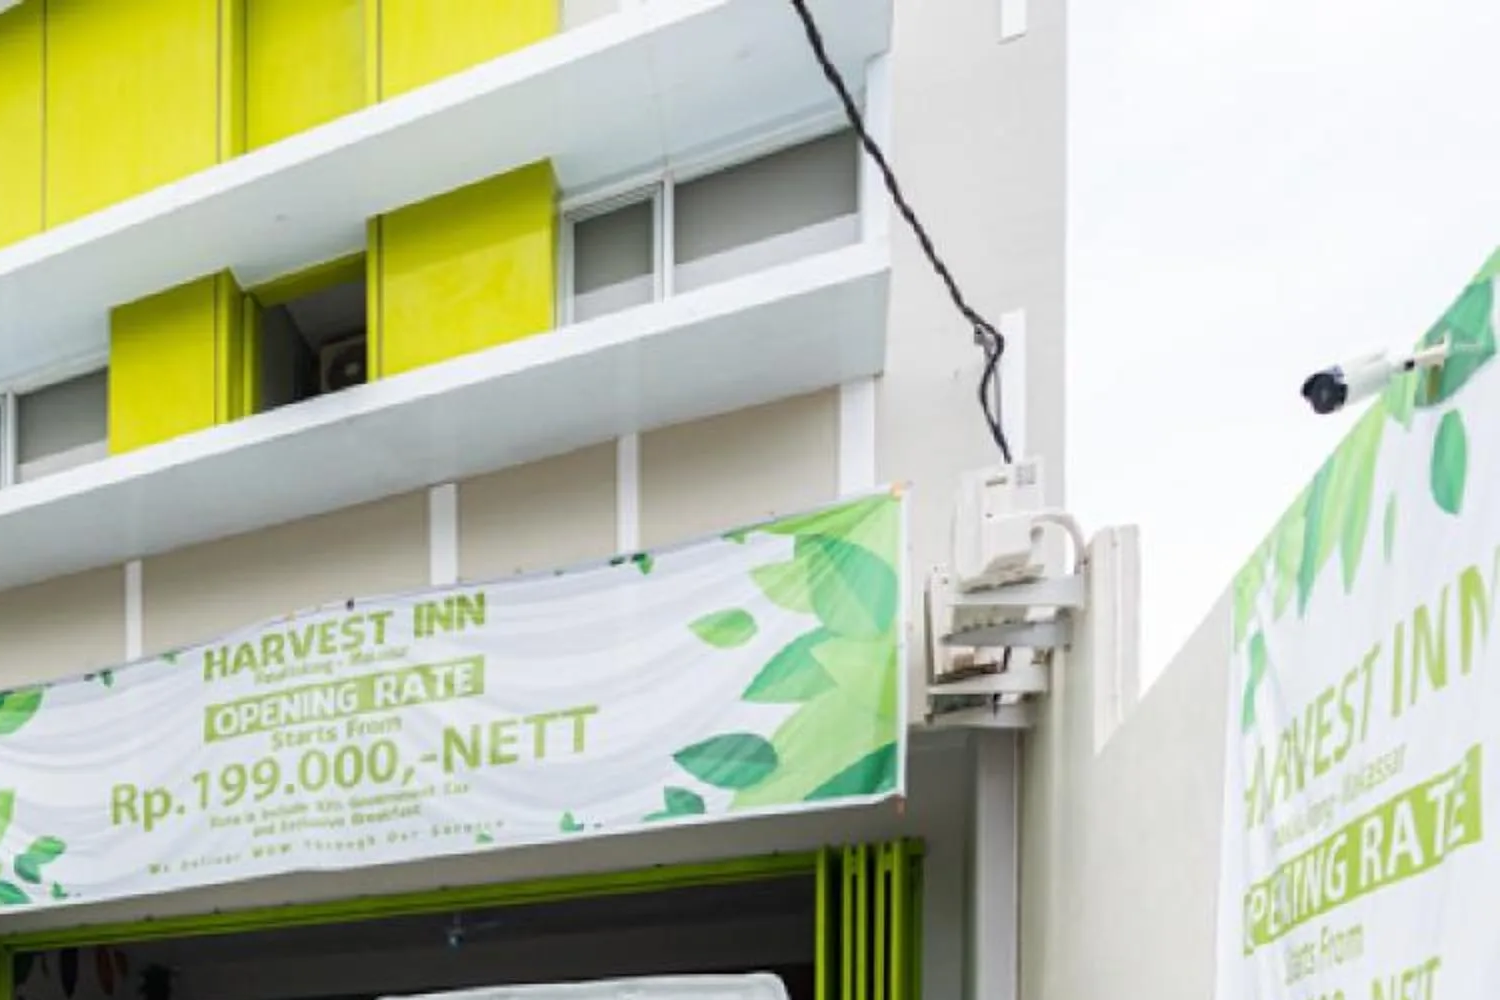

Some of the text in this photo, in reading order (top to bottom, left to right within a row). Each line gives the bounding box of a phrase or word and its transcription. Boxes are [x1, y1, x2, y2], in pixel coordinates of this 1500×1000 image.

[203, 610, 394, 682] HARVEST
[412, 591, 486, 639] INN
[213, 683, 359, 737] OPENING
[373, 662, 476, 709] RATE
[345, 716, 403, 740] From
